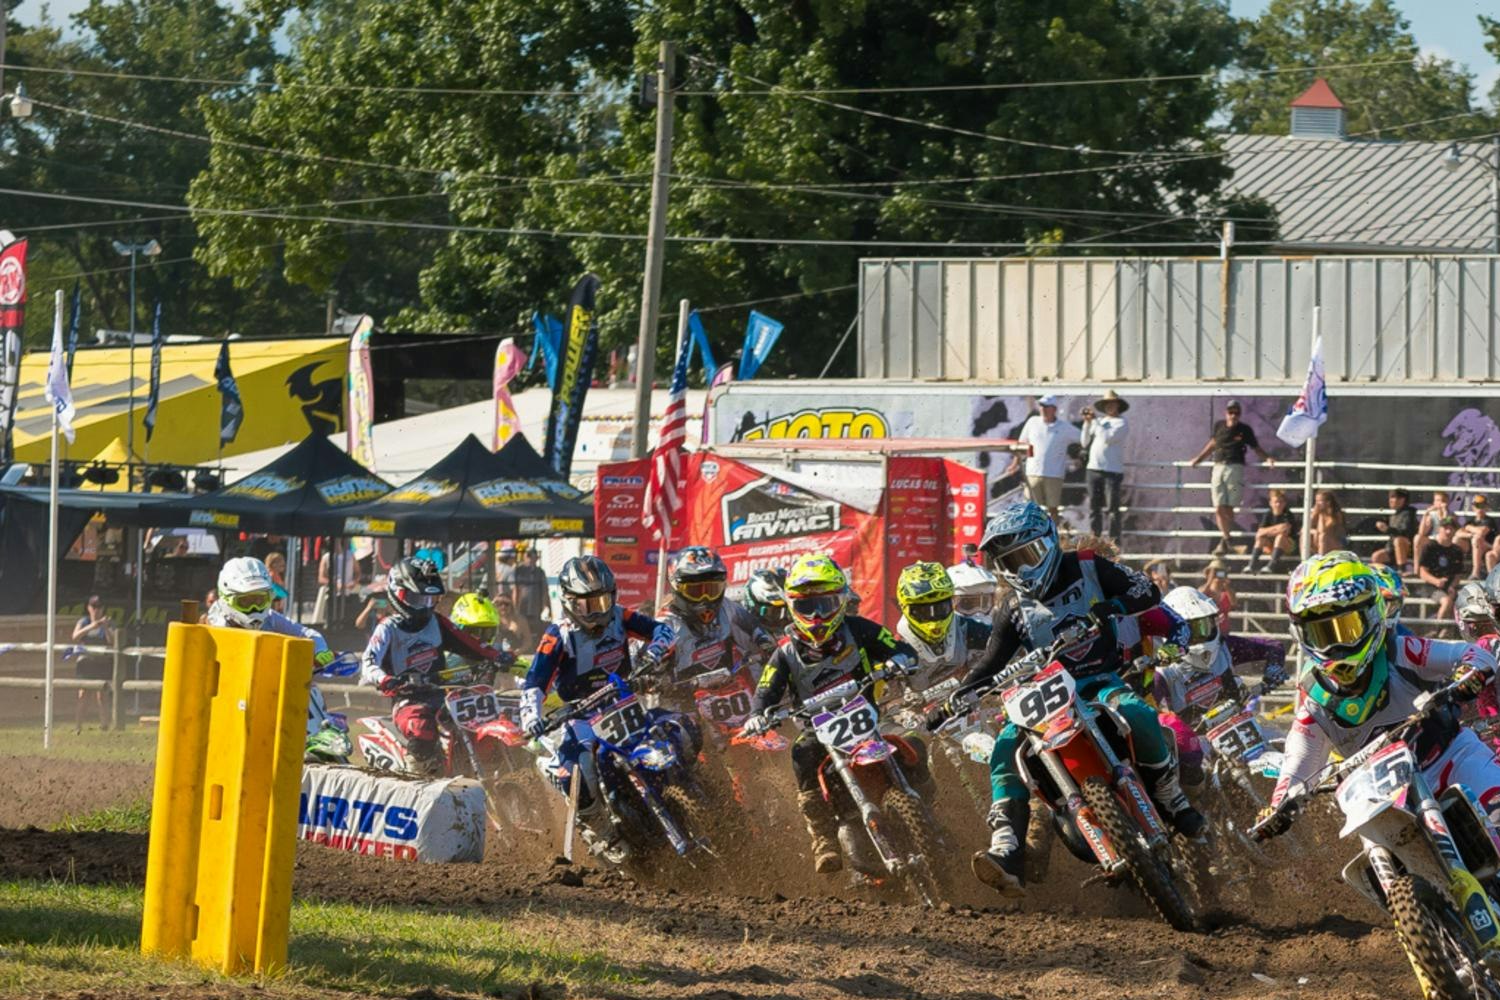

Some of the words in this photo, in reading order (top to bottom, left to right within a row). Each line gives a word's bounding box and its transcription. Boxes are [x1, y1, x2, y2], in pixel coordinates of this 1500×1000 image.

[890, 479, 922, 490] LUCAS
[923, 479, 938, 490] OIL
[456, 696, 498, 722] 59
[711, 693, 752, 722] 60
[1019, 674, 1070, 728] 95
[600, 701, 646, 746] 38
[828, 708, 876, 747] 28
[299, 793, 419, 841] RTS
